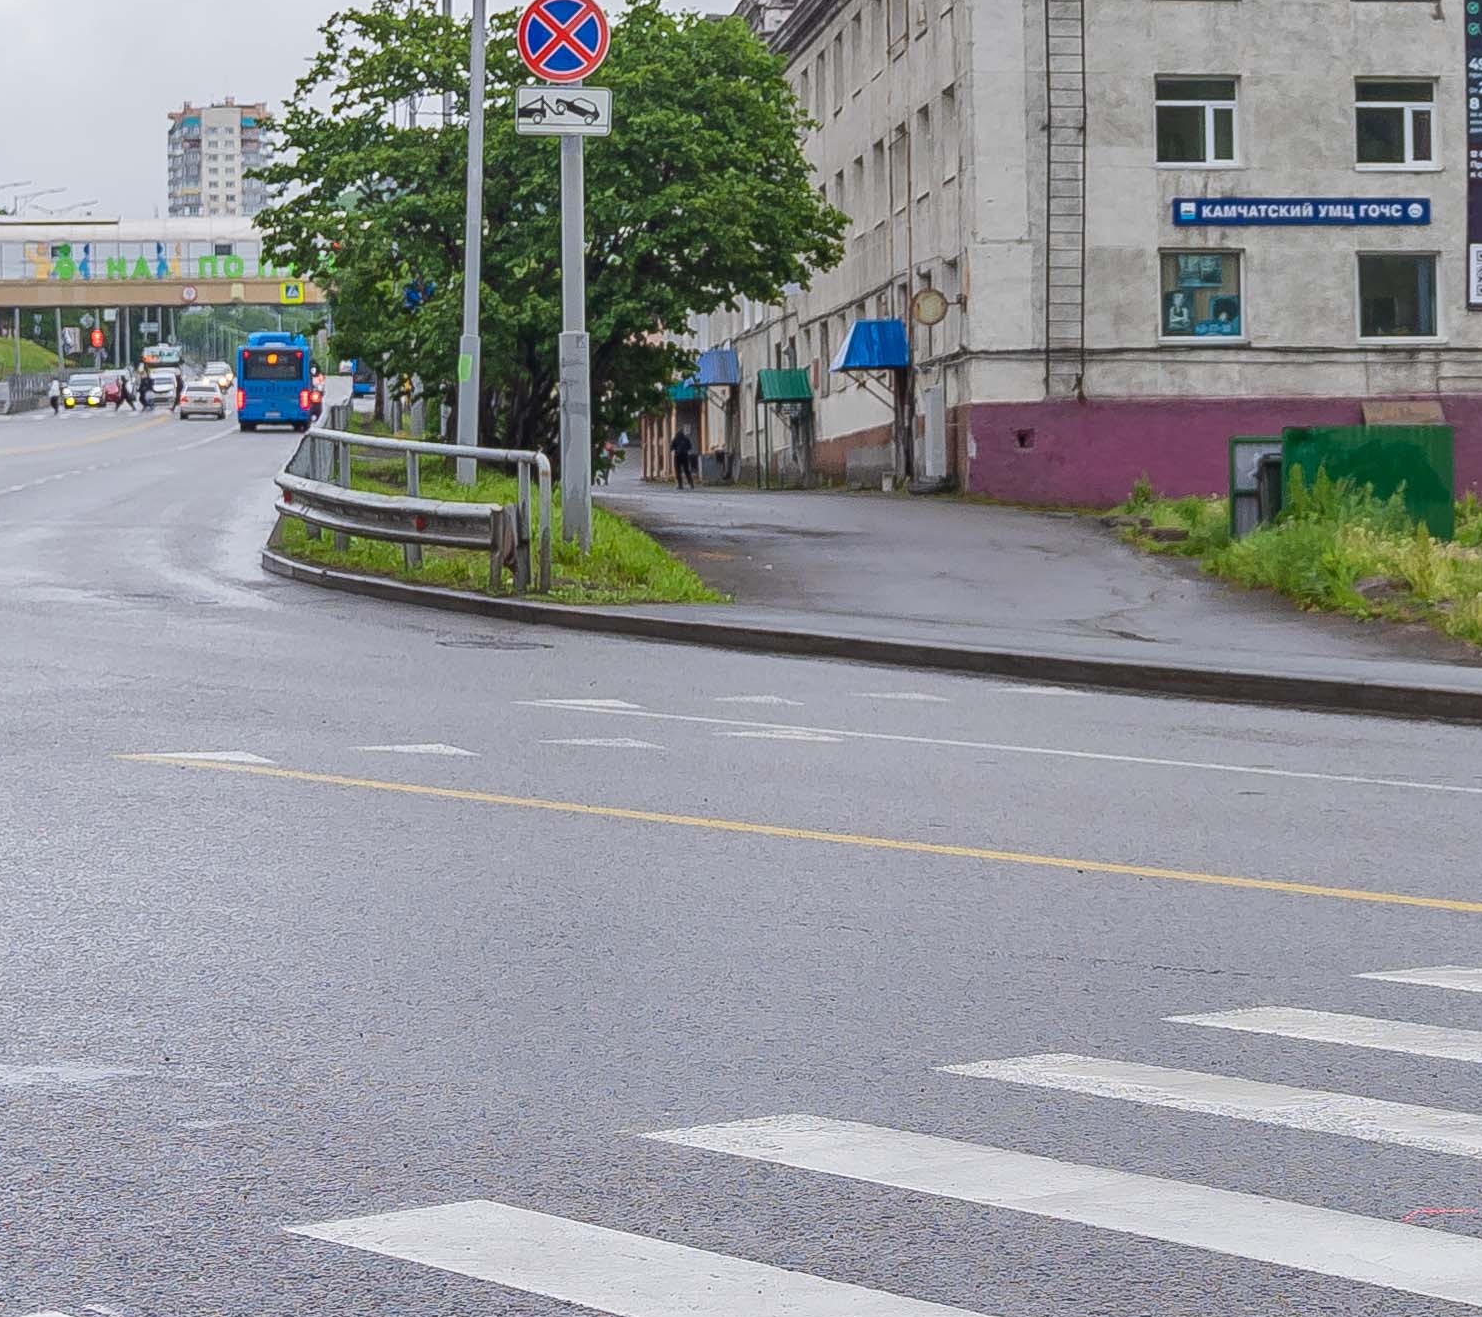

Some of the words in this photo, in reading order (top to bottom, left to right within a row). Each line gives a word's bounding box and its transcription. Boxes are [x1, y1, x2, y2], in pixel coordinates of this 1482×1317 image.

[1470, 98, 1479, 109] 8
[1202, 203, 1312, 218] КАМЧАТСКИЙ
[1319, 205, 1354, 219] УМЦ
[1360, 205, 1402, 217] ГОЧС
